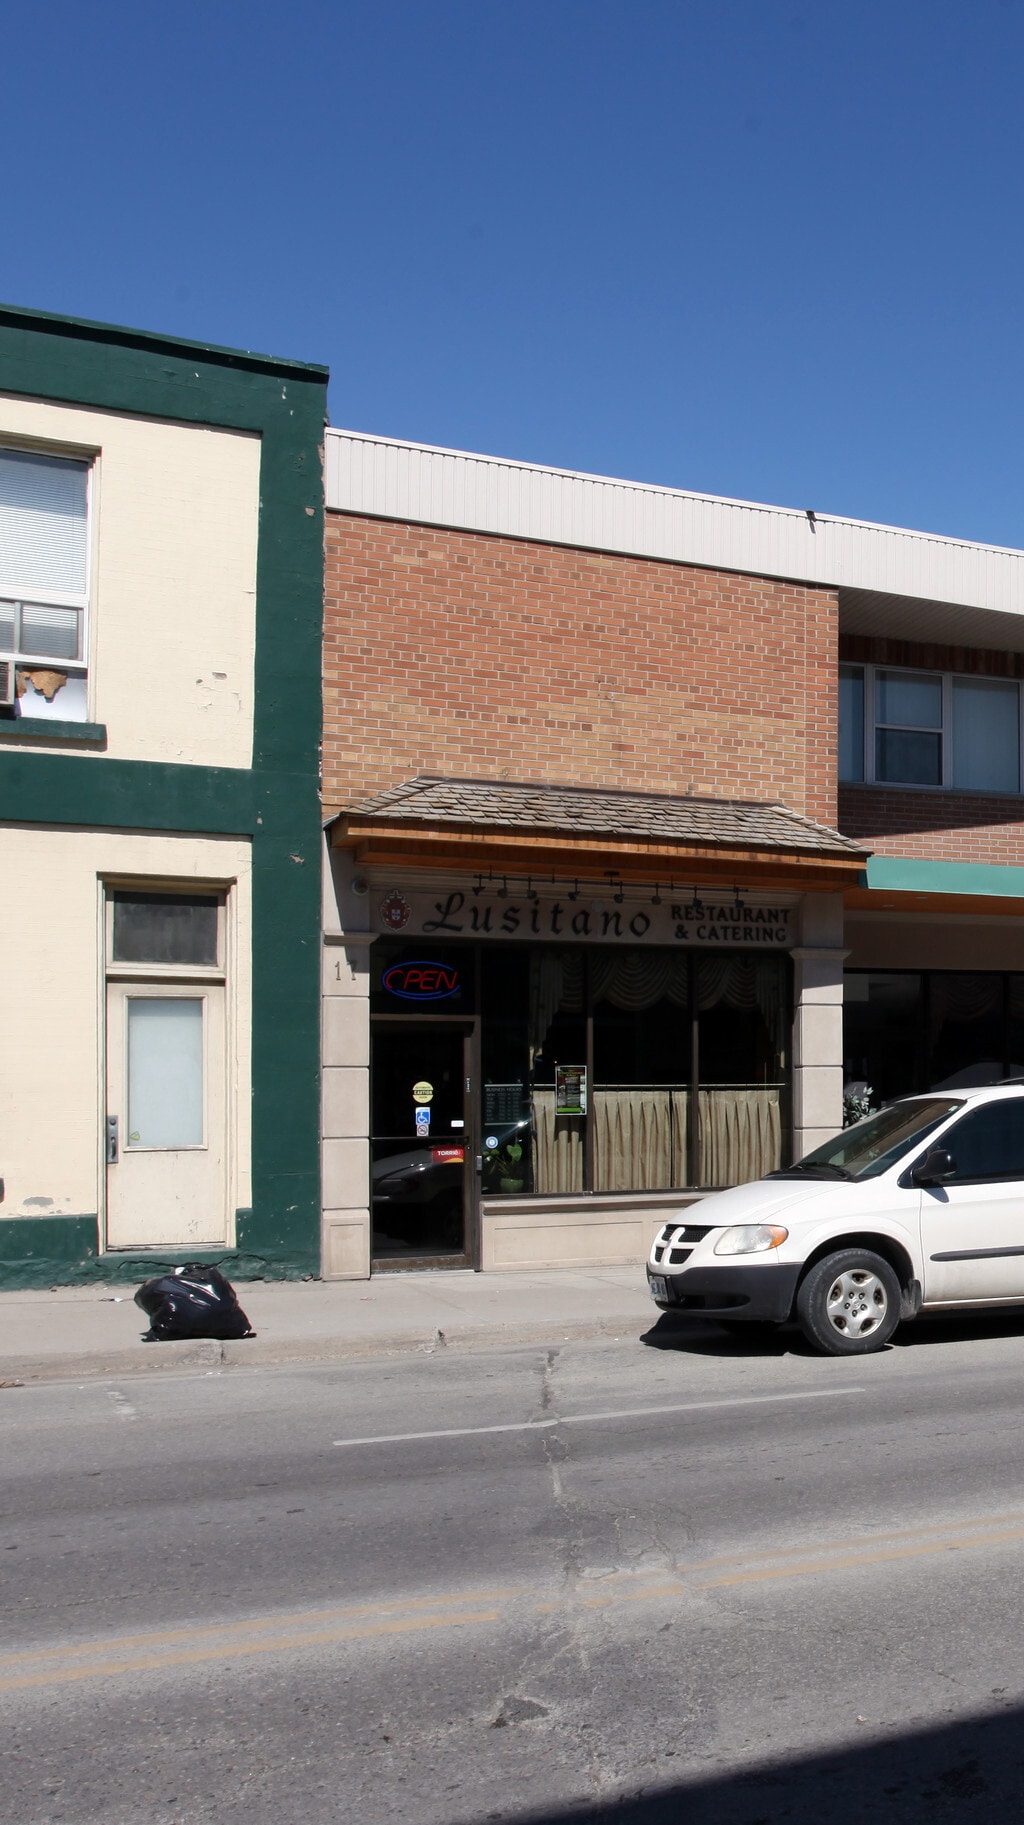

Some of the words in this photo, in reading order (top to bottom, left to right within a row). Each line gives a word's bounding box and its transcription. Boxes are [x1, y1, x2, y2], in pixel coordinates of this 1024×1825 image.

[422, 892, 651, 938] Lusitano
[671, 904, 790, 924] RESTAURANT
[675, 924, 689, 940] &
[696, 925, 787, 942] CATERING
[335, 961, 357, 981] 17
[385, 969, 458, 990] OPEN
